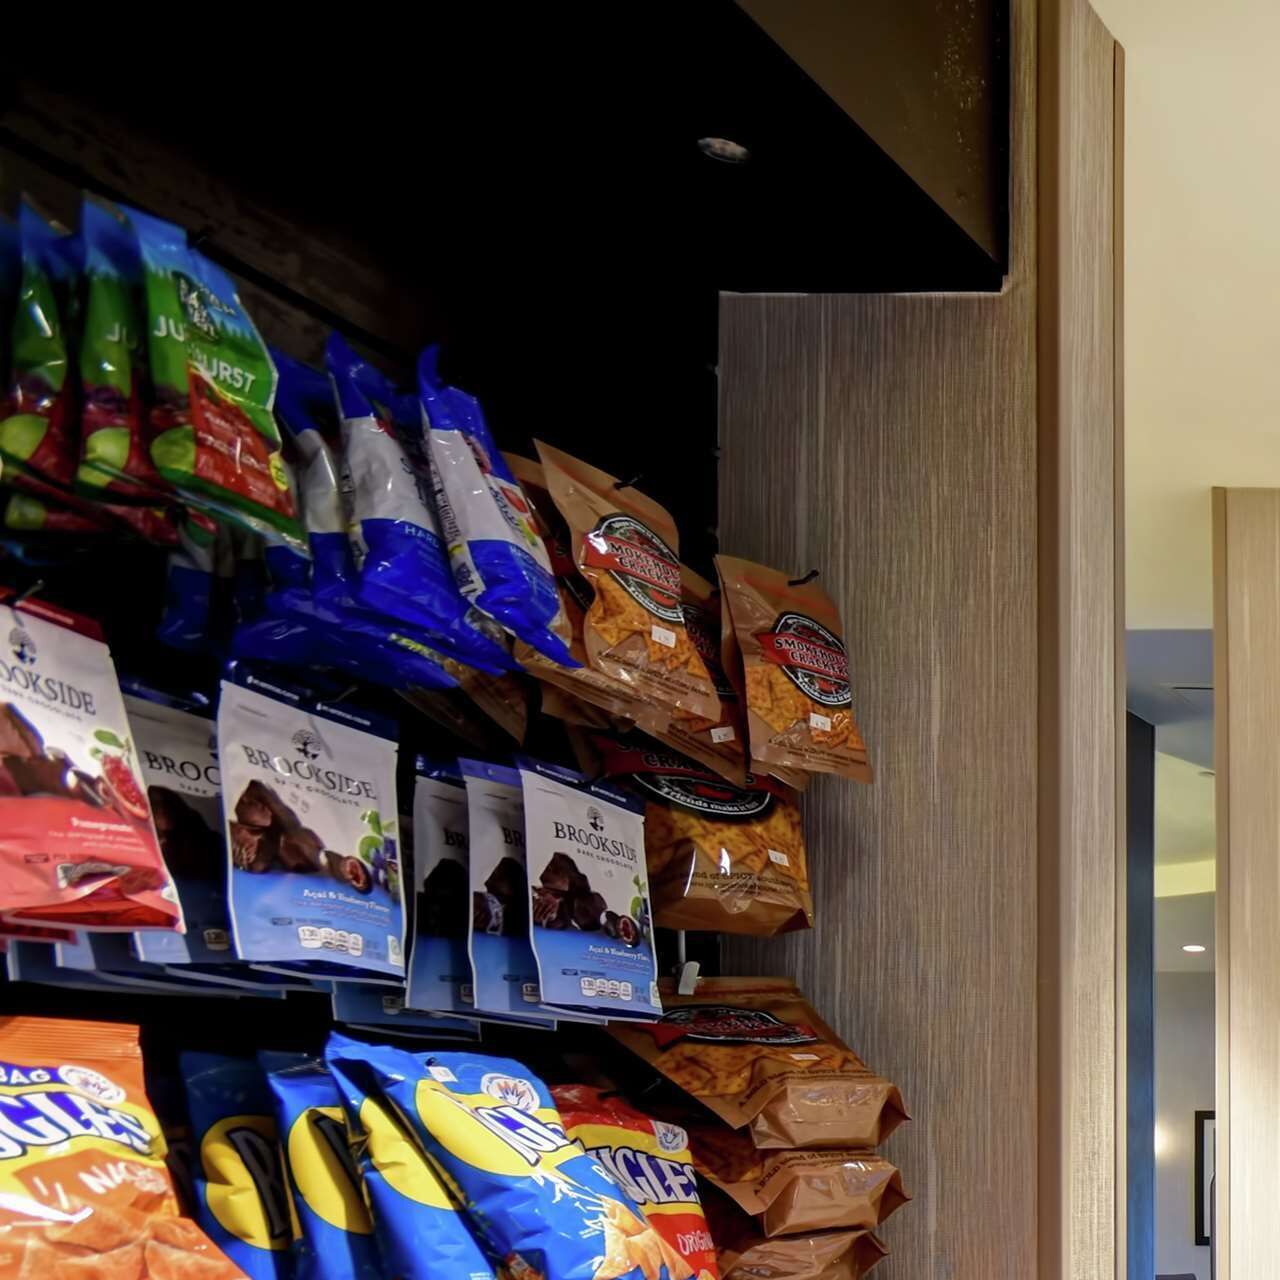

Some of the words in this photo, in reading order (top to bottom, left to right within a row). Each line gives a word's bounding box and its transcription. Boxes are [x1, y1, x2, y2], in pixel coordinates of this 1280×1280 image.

[242, 744, 377, 800] BROOKSIDE
[553, 821, 638, 864] BROOKSIDE
[0, 1092, 153, 1156] GLES
